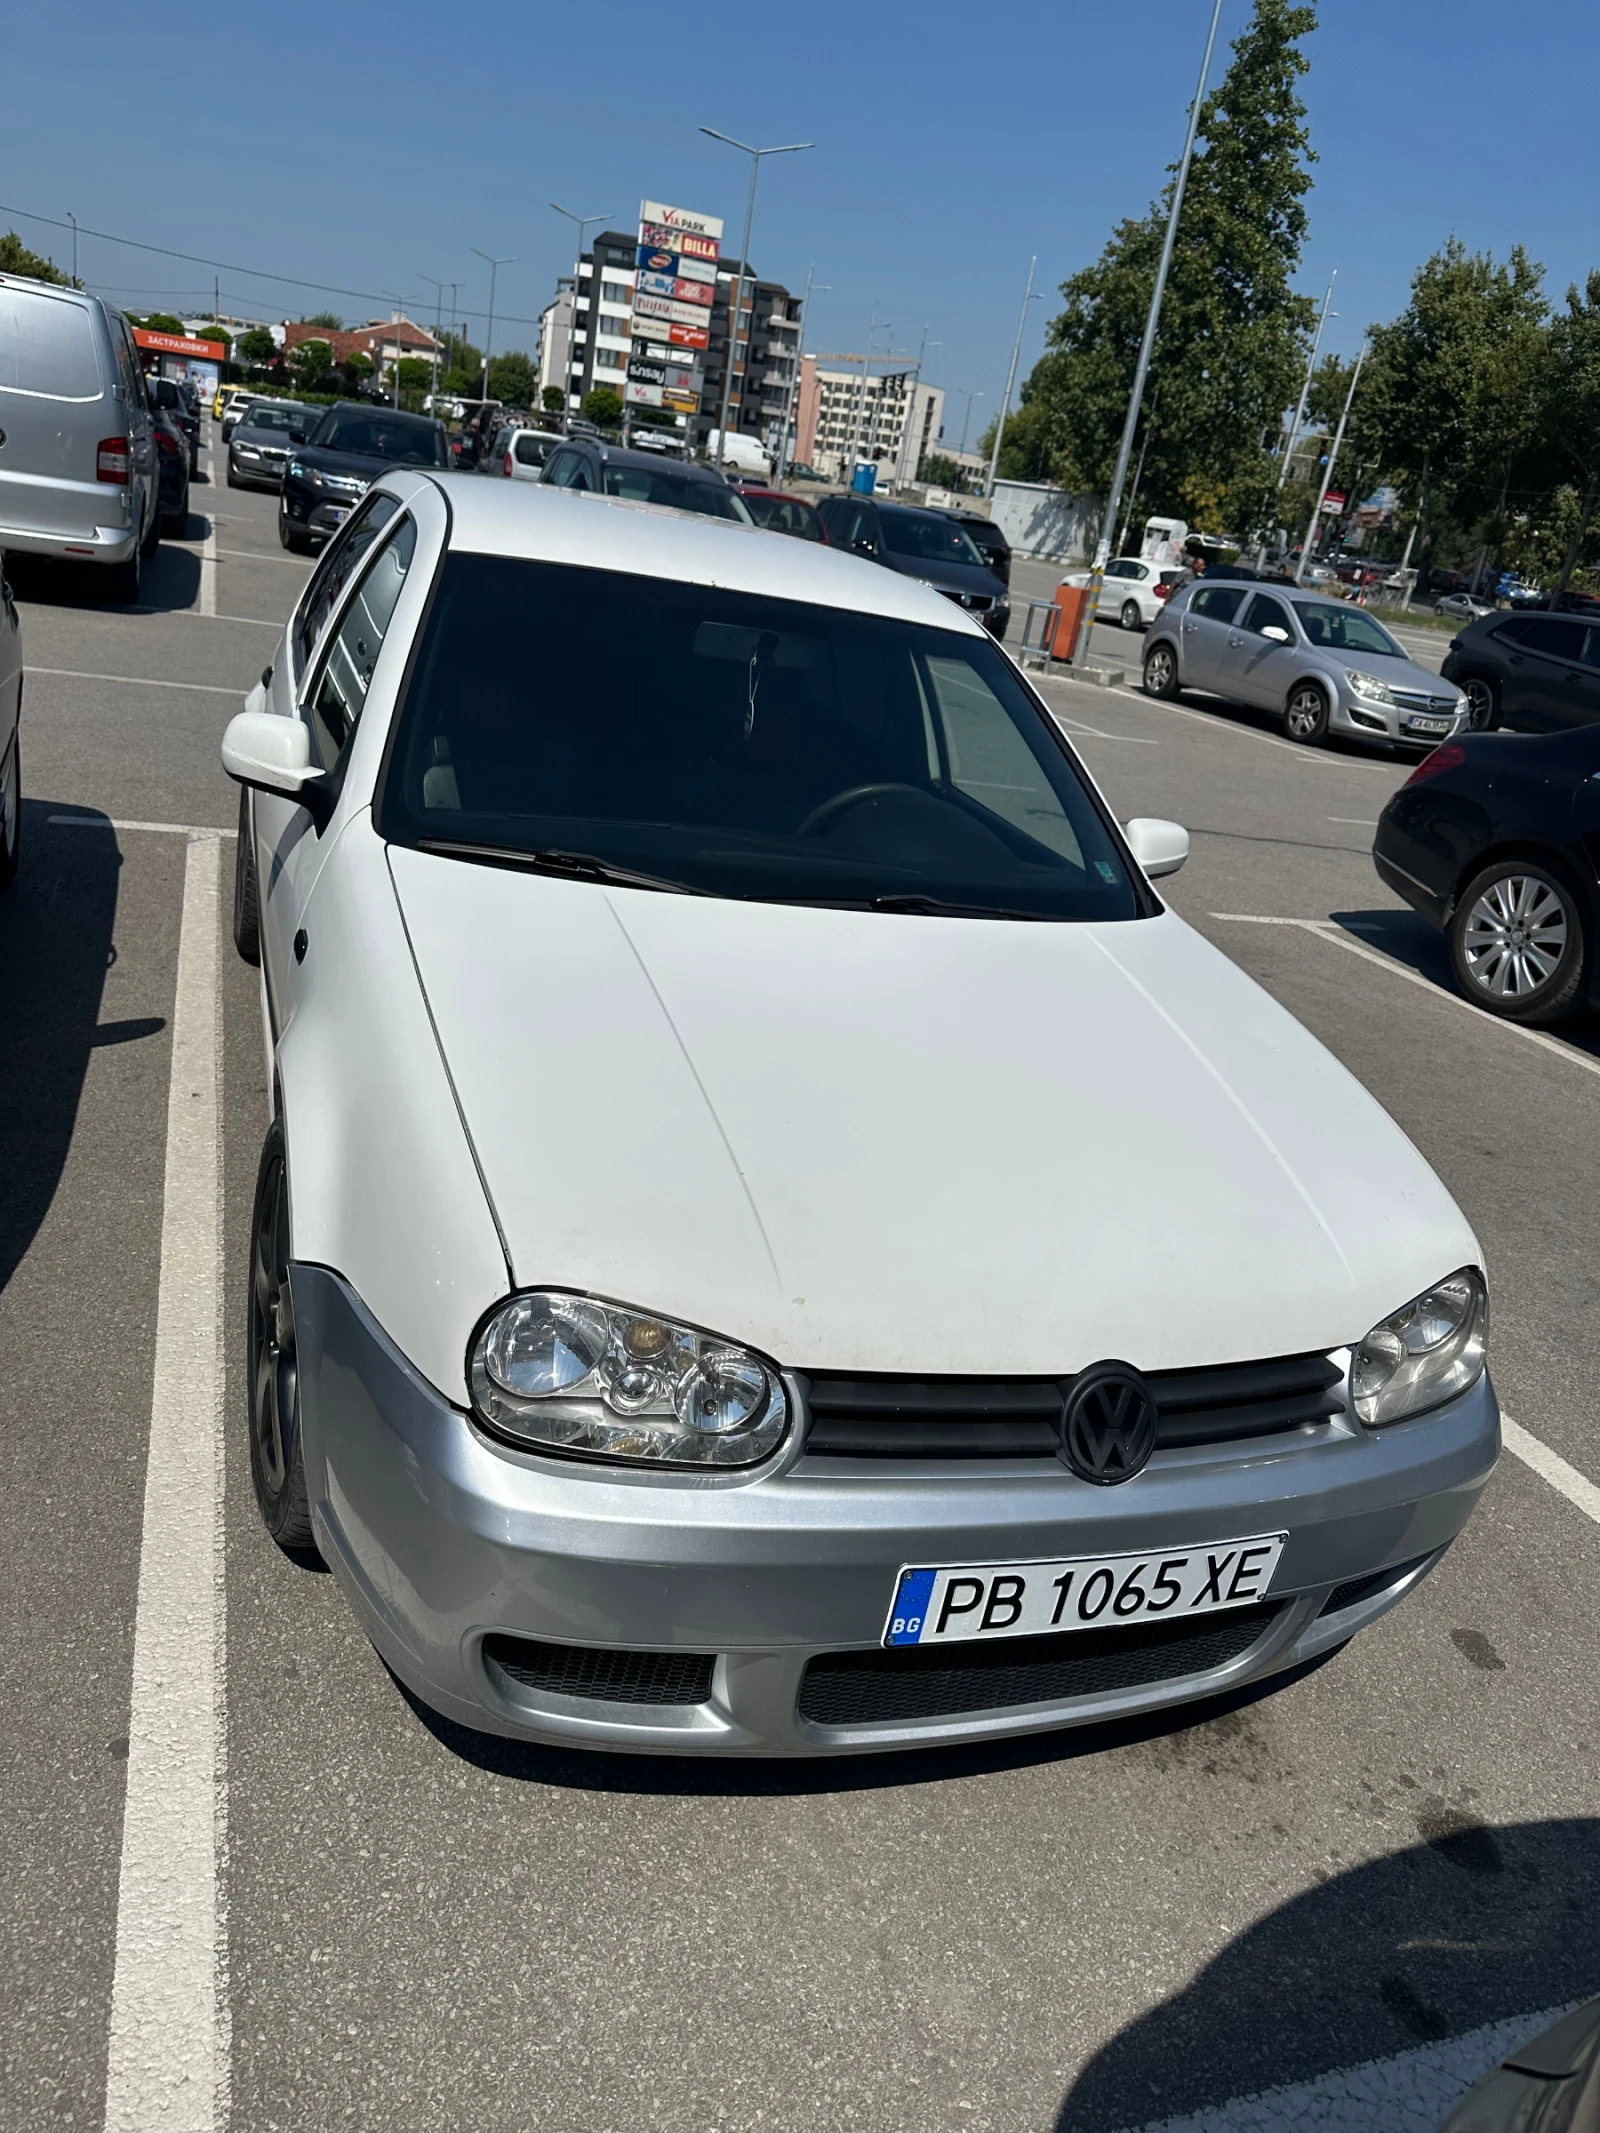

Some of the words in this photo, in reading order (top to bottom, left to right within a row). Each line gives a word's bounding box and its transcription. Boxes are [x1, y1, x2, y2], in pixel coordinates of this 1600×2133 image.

[662, 208, 681, 226] VIA
[681, 219, 707, 233] PARK
[683, 237, 717, 259] BILLA
[147, 335, 209, 353] ЗАСТРАХОВКИ
[629, 363, 666, 385] sinsay
[934, 1574, 1026, 1635] PB
[1050, 1557, 1189, 1626] 1065
[1189, 1545, 1273, 1608] XE
[891, 1617, 922, 1635] BG
